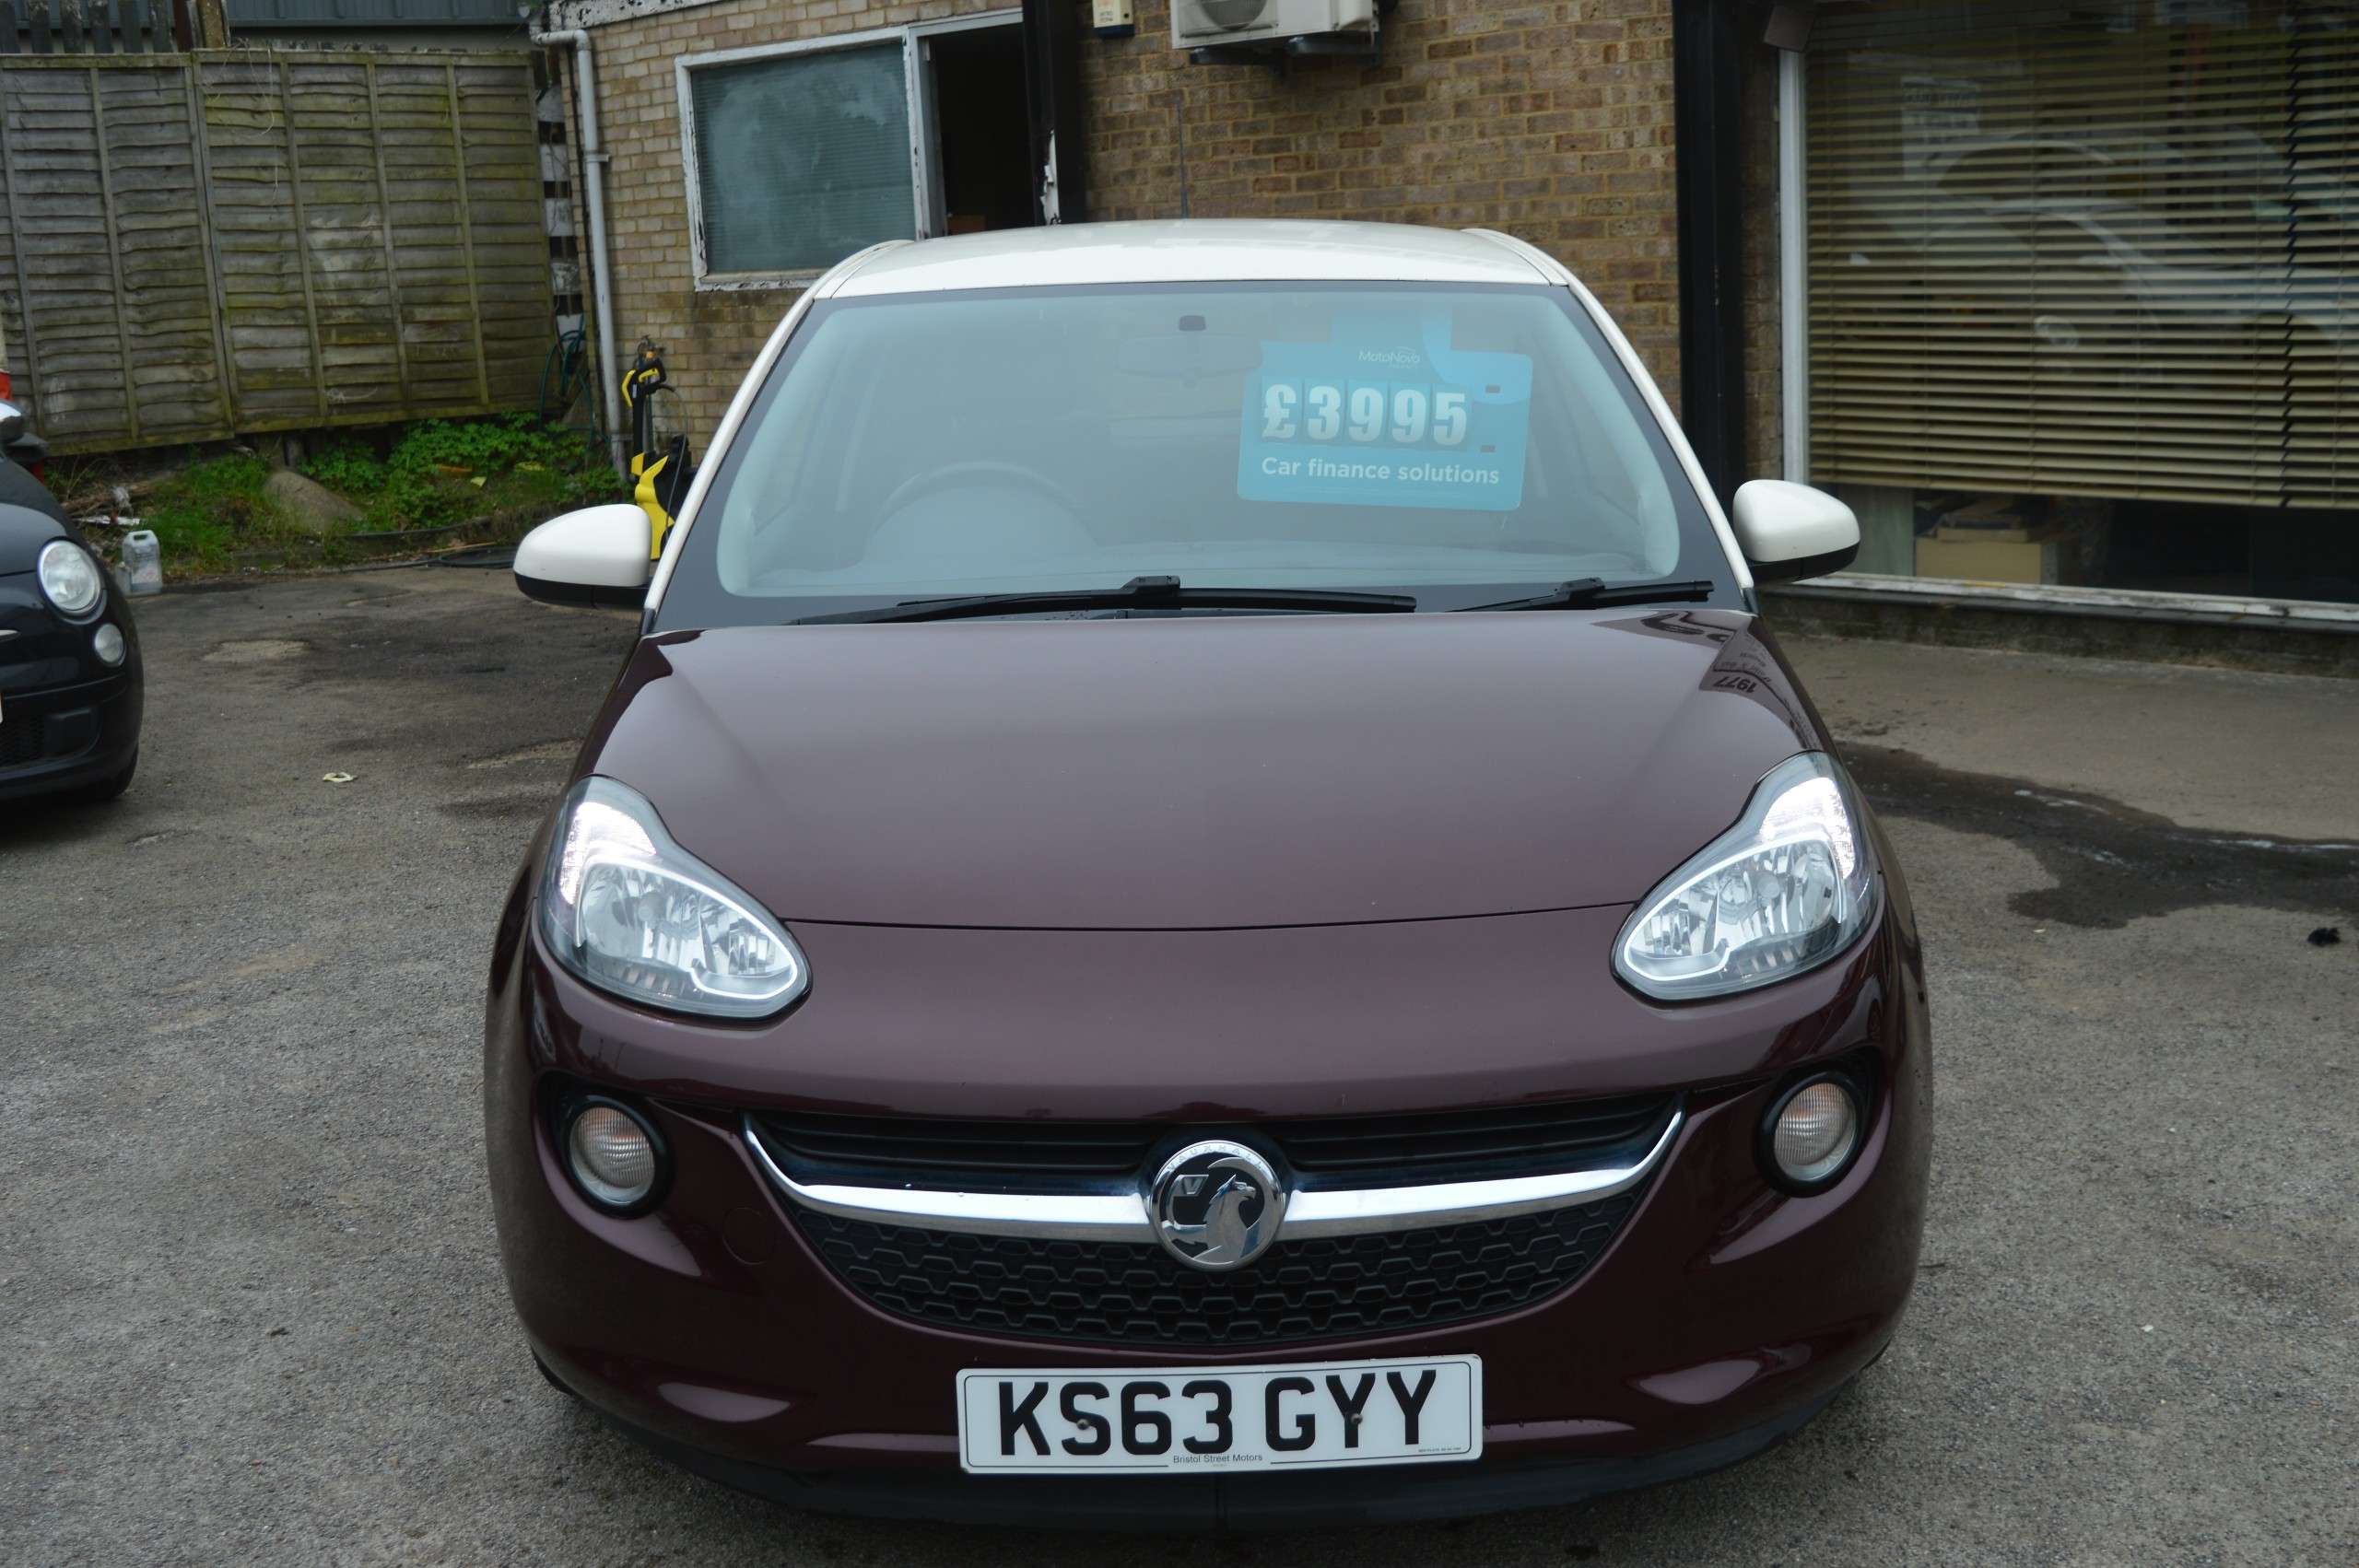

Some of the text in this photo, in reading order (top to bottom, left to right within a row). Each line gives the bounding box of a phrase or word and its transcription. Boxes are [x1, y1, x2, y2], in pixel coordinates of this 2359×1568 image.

[1262, 383, 1468, 446] £3995
[1262, 457, 1500, 485] Car finance solutions
[998, 1369, 1438, 1455] KS63 GYY
[1173, 1453, 1263, 1464] Bristol Street Motors
